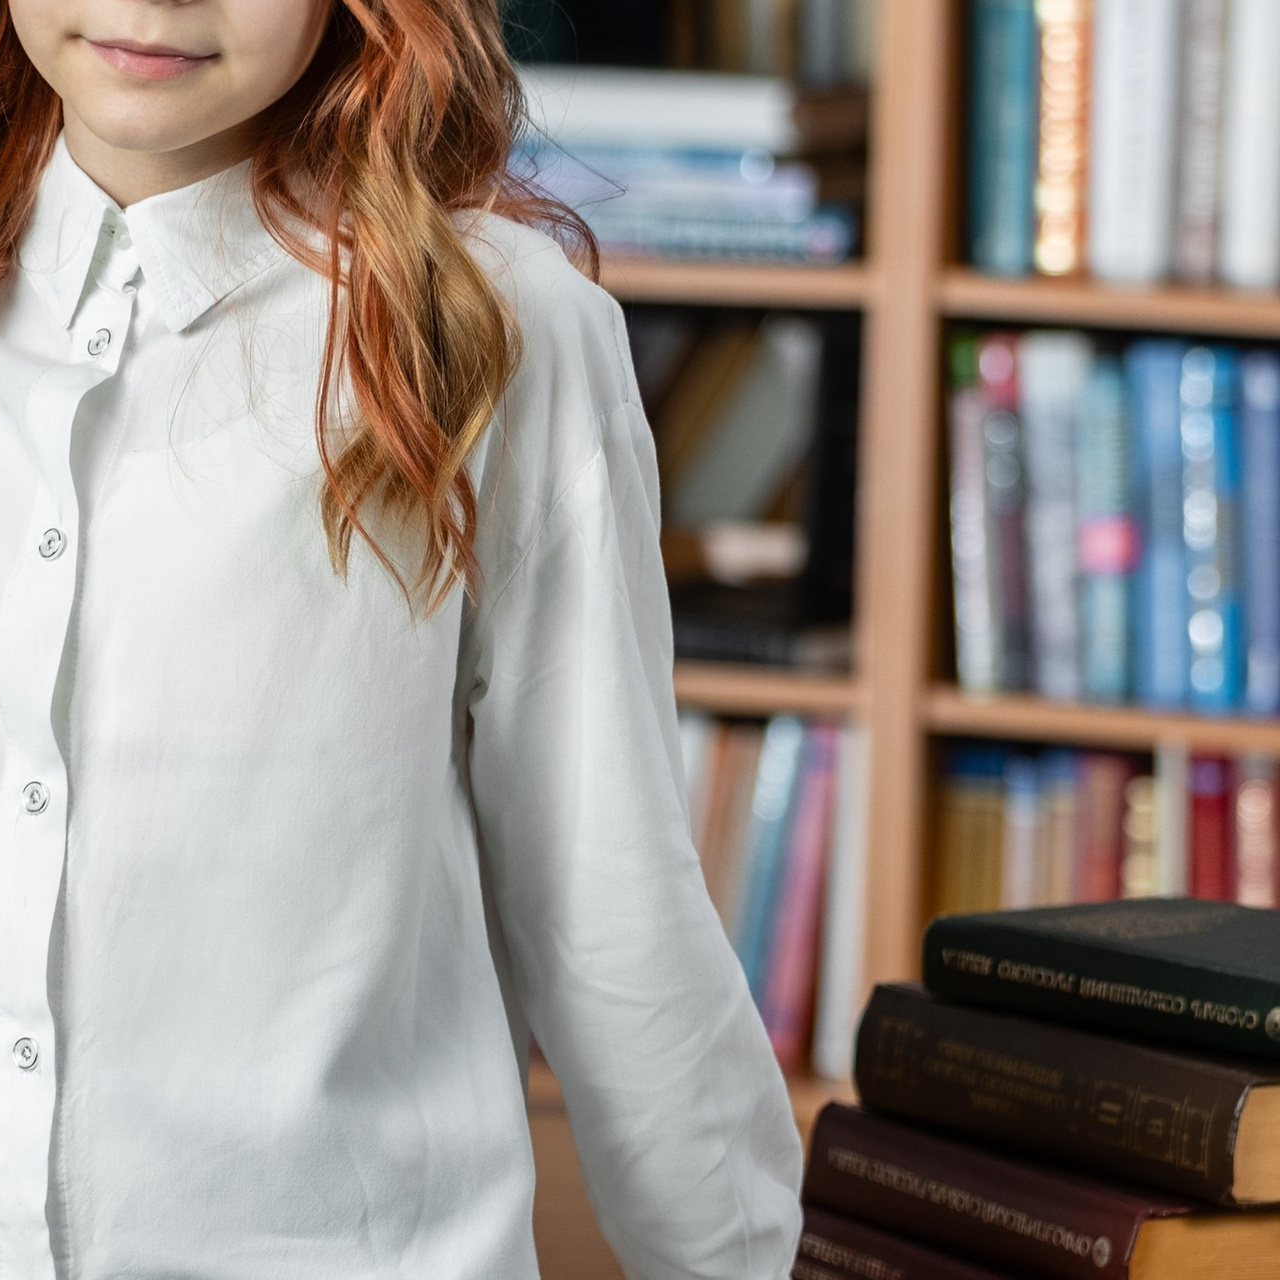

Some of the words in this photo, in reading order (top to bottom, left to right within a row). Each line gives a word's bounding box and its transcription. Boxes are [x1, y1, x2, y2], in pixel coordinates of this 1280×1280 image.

[940, 947, 992, 976] ЯЗЫКА
[996, 959, 1076, 993] РУССКОГО
[1079, 977, 1187, 1015] СОКРАЩЕНИЙ
[1189, 999, 1259, 1030] СЛОВАРЬ
[866, 1161, 929, 1199] РУССКОГО
[924, 1180, 983, 1219] СЛОВАРЬ
[978, 1200, 1092, 1258] ОРФОЭПИЧЕСКИЙ
